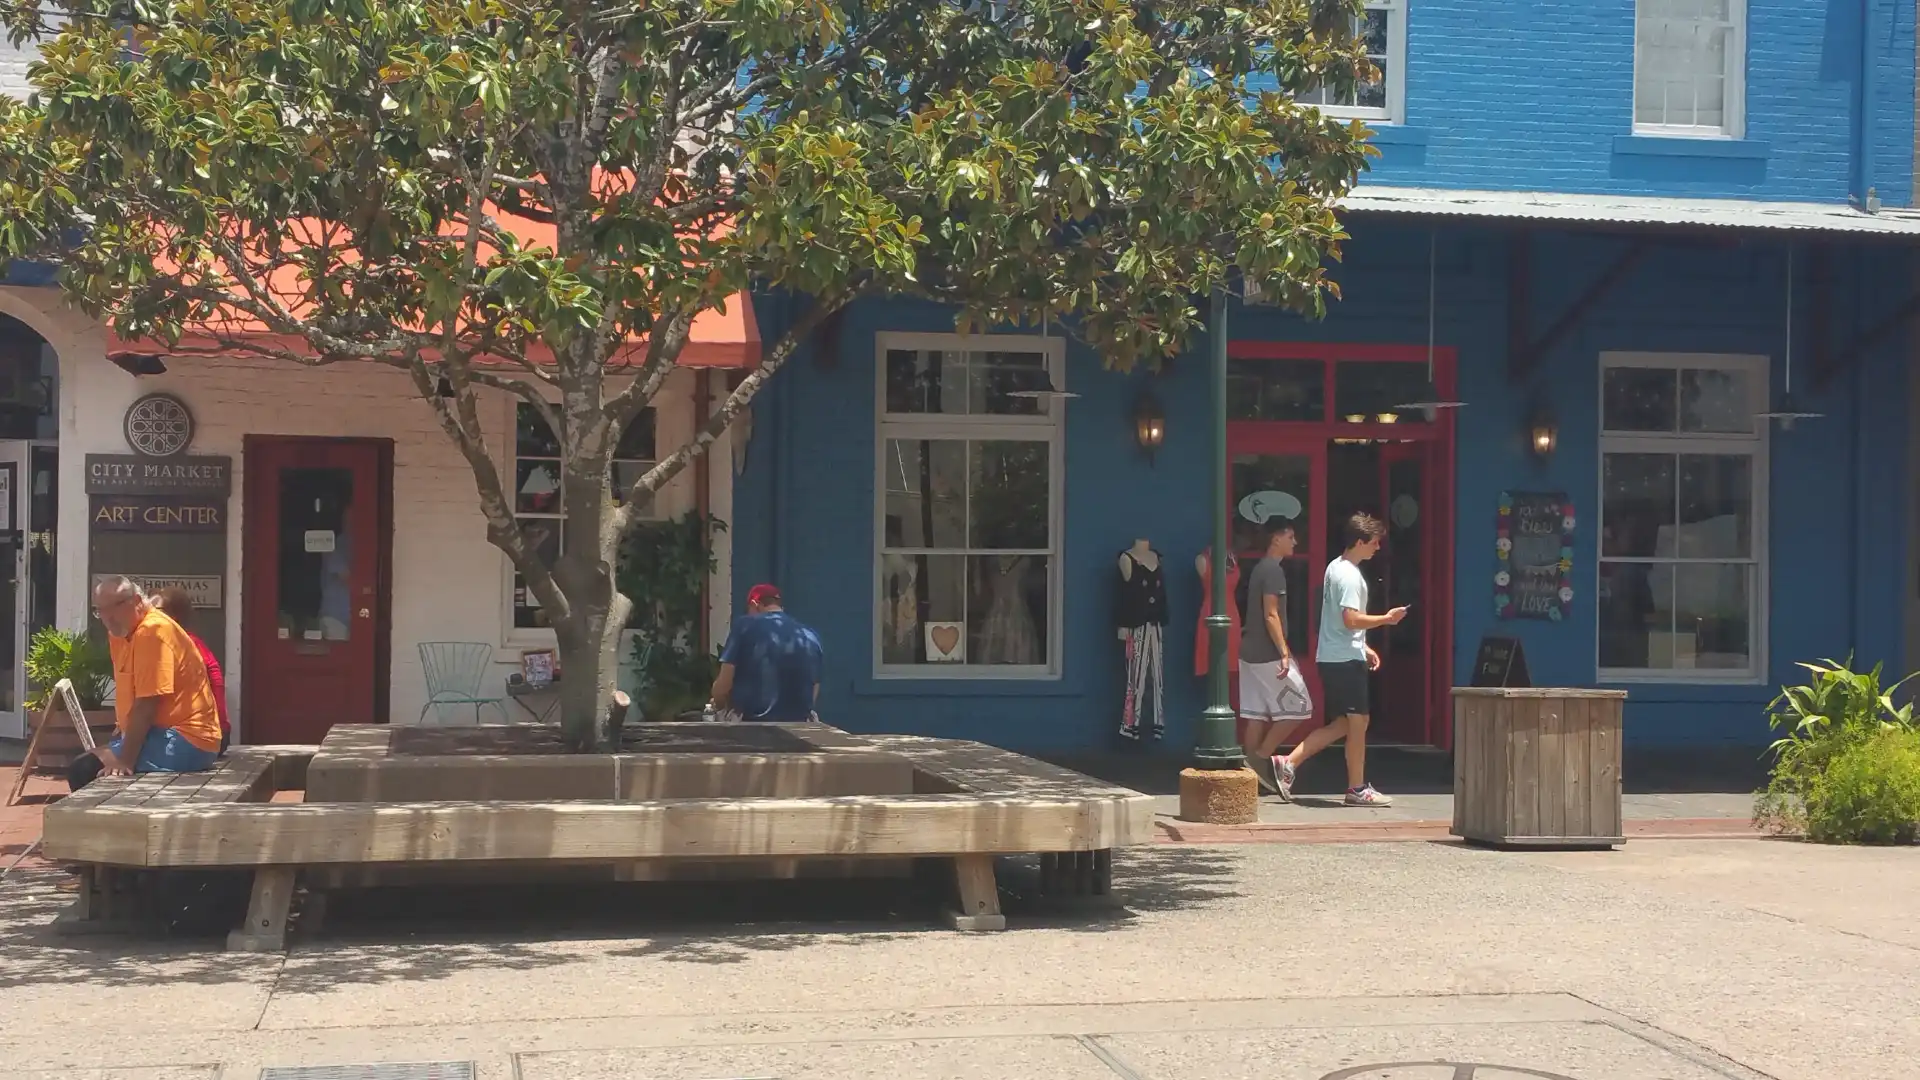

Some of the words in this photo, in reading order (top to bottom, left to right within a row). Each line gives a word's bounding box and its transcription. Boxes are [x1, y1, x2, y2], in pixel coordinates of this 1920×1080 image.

[92, 463, 135, 477] CITY
[144, 464, 223, 479] MARKET
[95, 505, 139, 524] ART
[143, 506, 219, 524] CENTER
